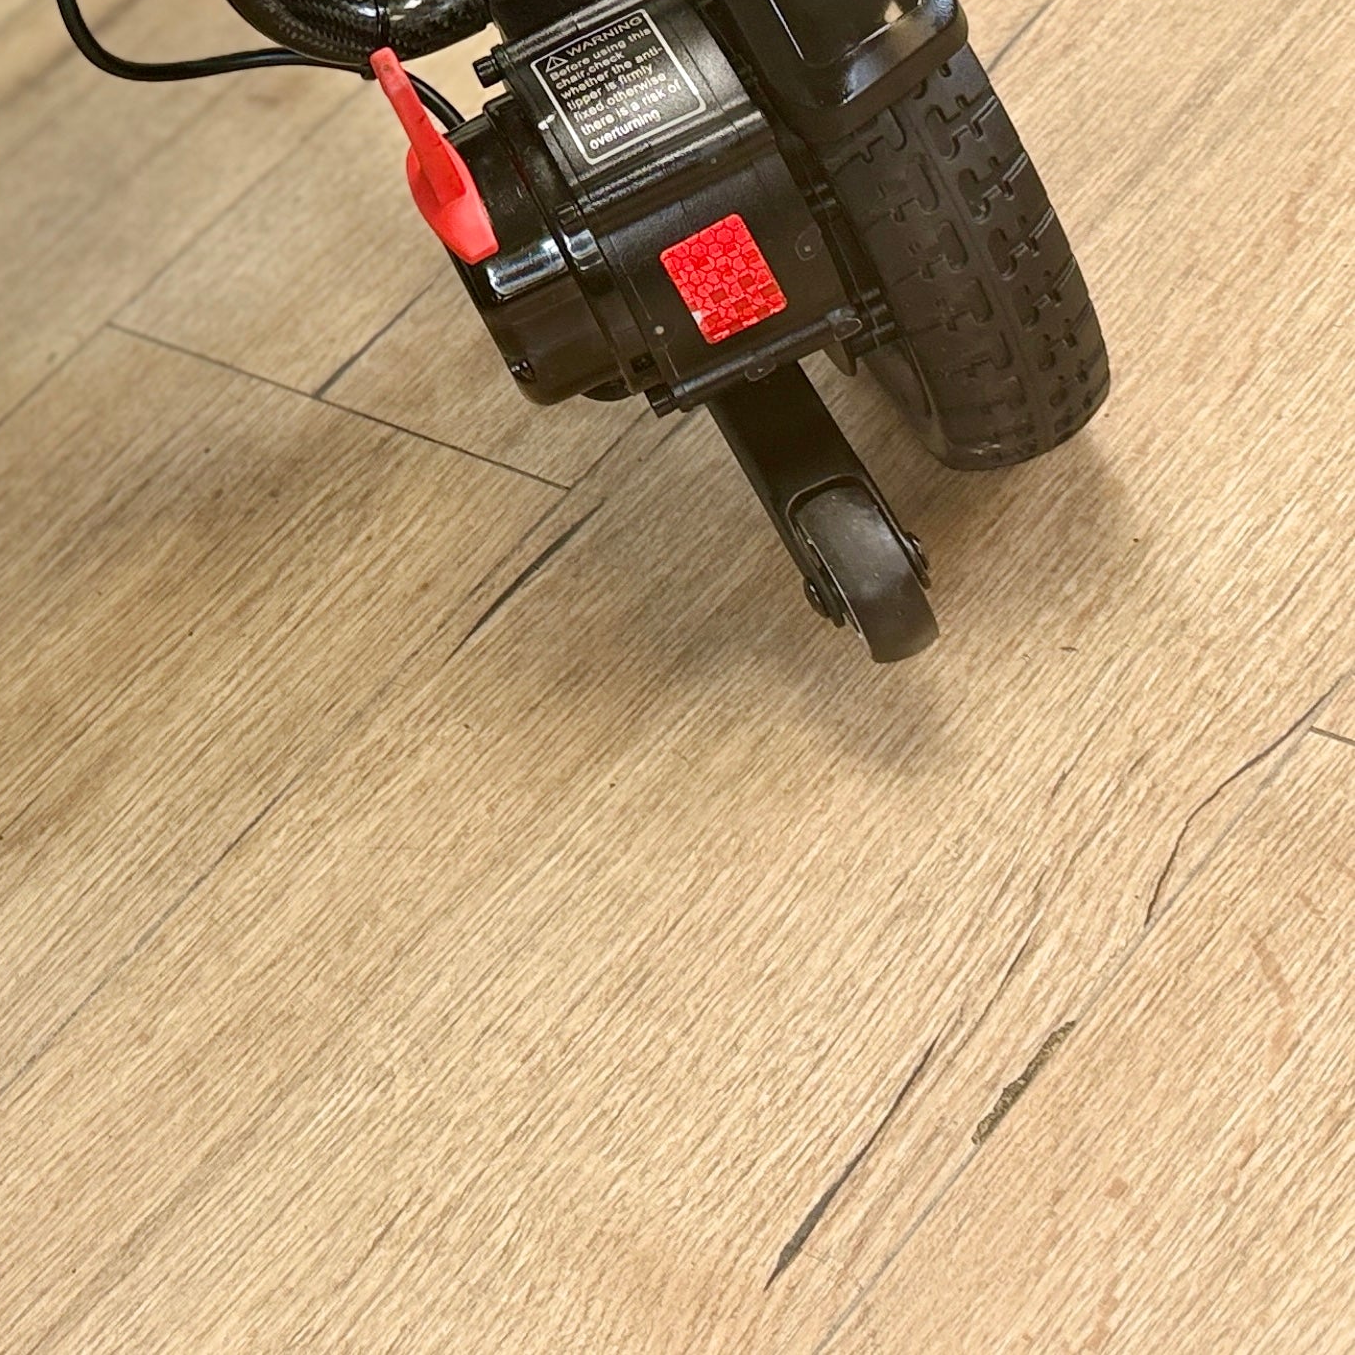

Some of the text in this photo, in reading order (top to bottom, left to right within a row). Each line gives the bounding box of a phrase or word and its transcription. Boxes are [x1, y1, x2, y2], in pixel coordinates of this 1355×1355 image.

[550, 28, 651, 81] Before using this
[566, 16, 642, 56] WARNING
[561, 71, 608, 99] whether
[611, 61, 632, 74] the
[567, 64, 652, 110] tipper is firmly
[581, 79, 681, 135] there is a risk of
[590, 109, 661, 149] overturning
